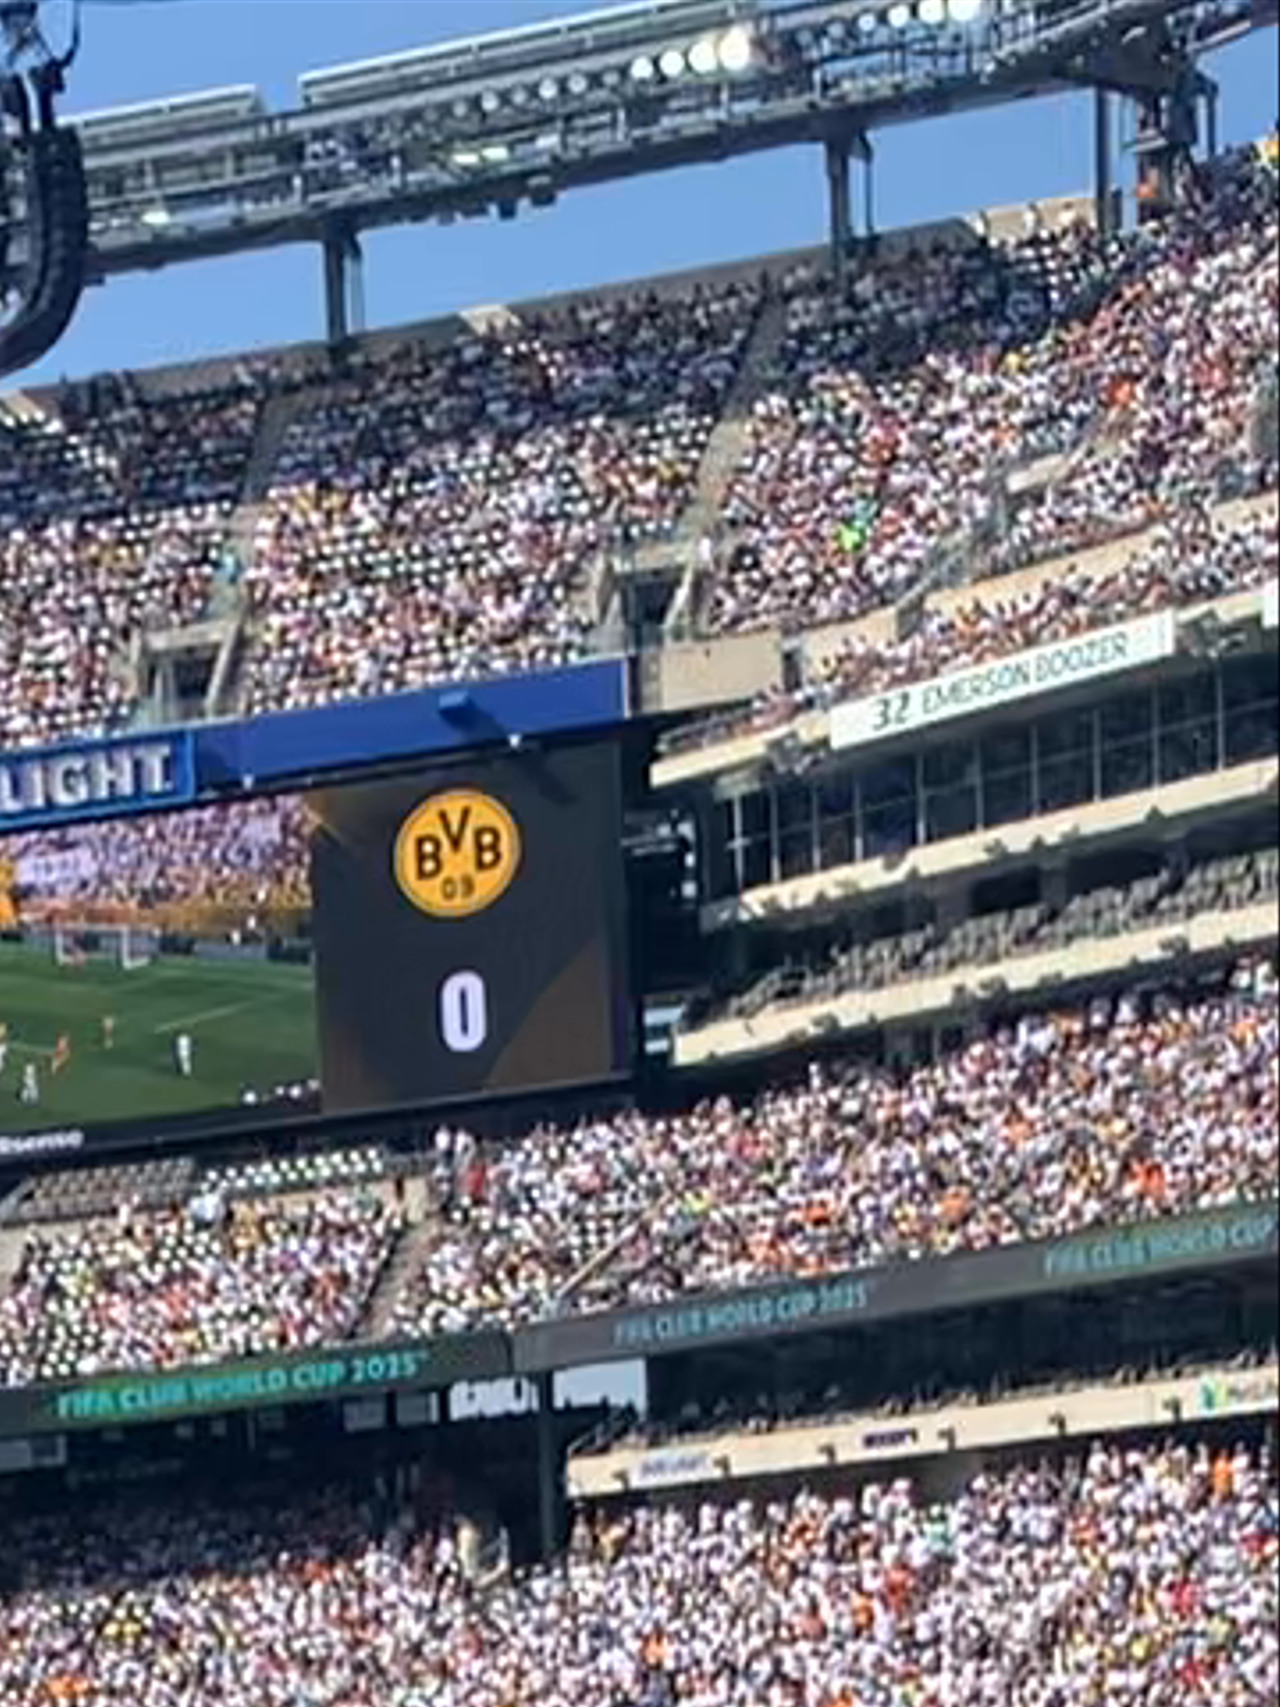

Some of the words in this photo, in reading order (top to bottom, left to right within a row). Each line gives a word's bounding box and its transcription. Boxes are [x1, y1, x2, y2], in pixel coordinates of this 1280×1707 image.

[872, 692, 911, 731] 32
[922, 659, 1030, 712] EMERSON
[414, 806, 502, 880] BVB
[442, 970, 486, 1052] 0
[57, 1390, 118, 1418] FIFA
[194, 1369, 287, 1399] WORLD
[293, 1362, 346, 1389] CUP
[350, 1354, 418, 1383] 2025
